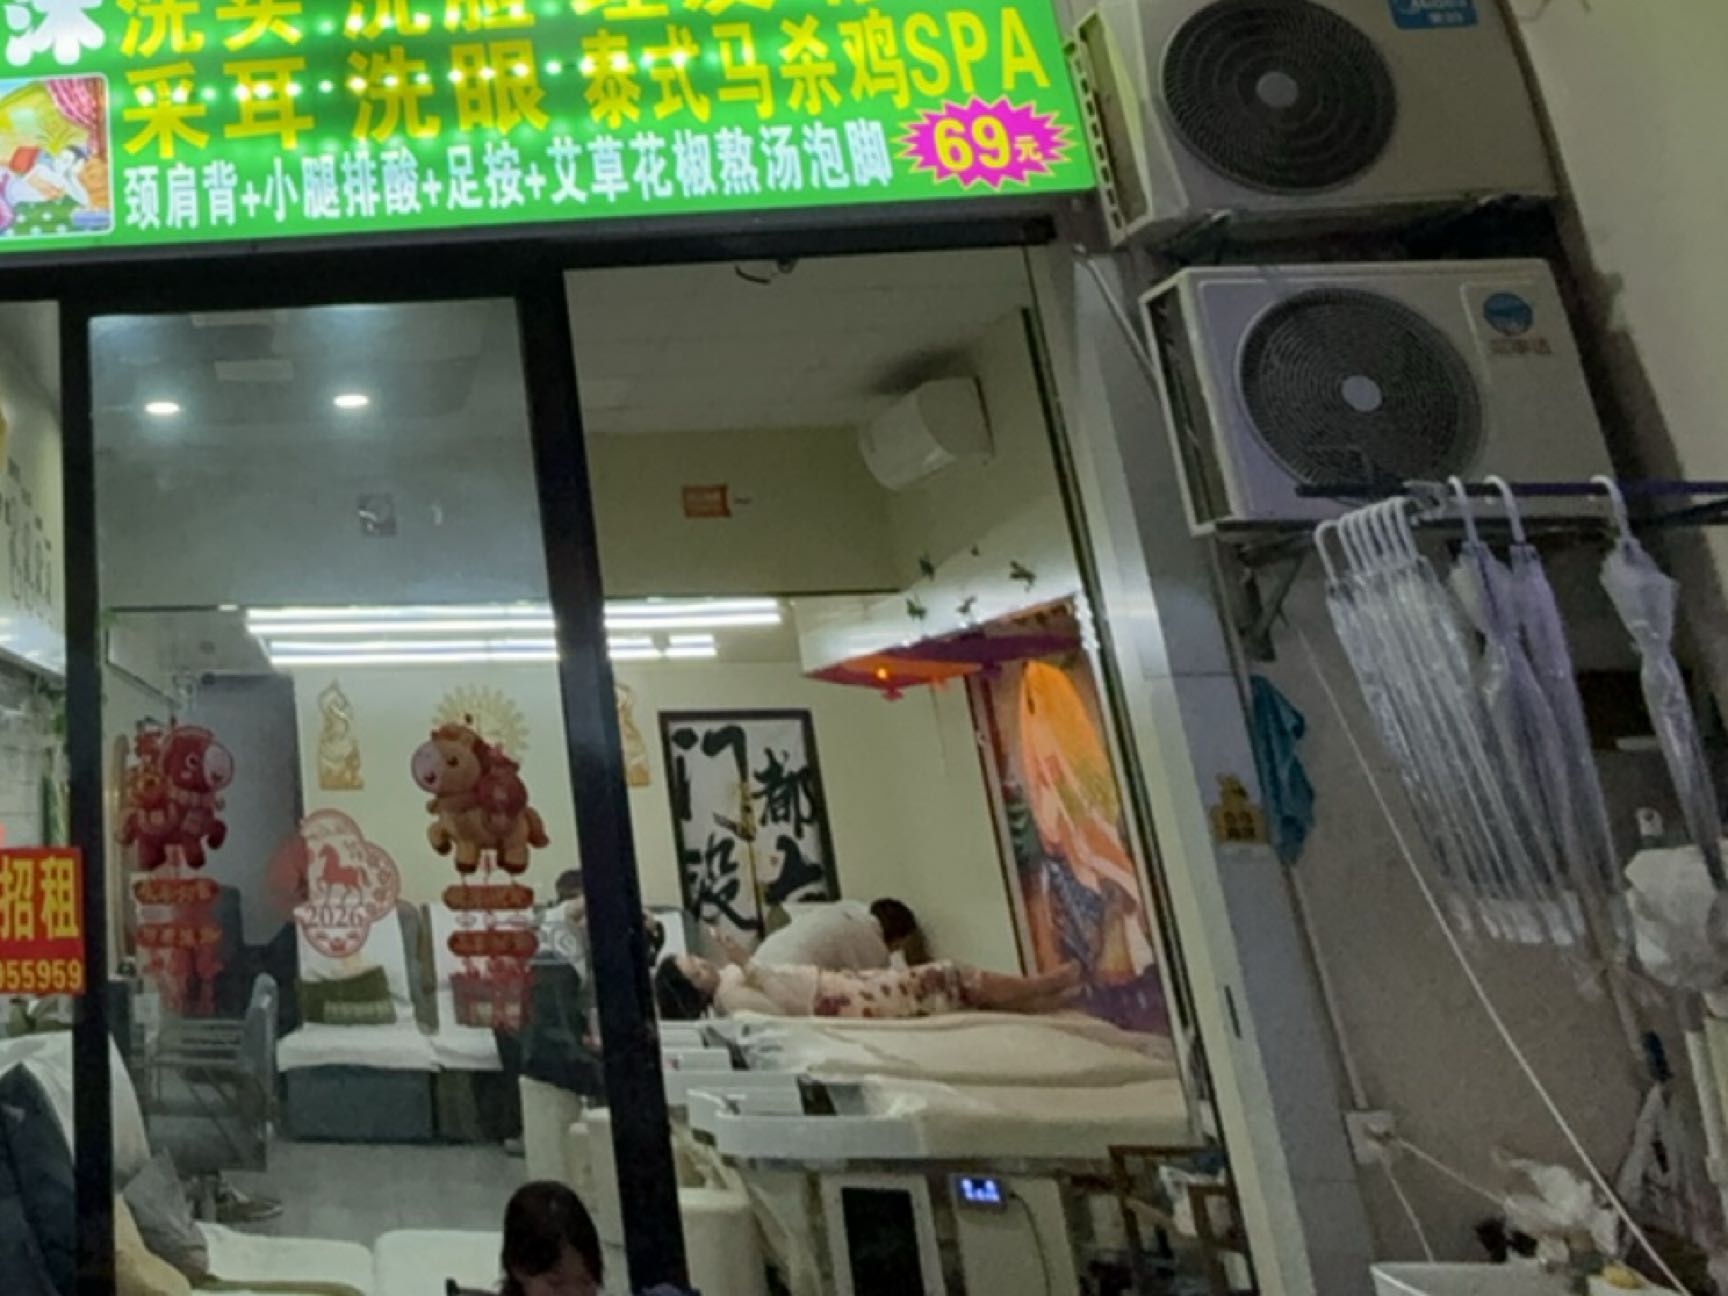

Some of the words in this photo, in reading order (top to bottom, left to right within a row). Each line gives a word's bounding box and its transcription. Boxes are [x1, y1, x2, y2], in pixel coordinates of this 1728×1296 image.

[122, 56, 315, 158] 采耳
[346, 42, 550, 142] 洗眼
[580, 7, 1050, 129] 泰式马杀鸡SPA
[933, 115, 1044, 172] 69元
[302, 904, 368, 928] 2026
